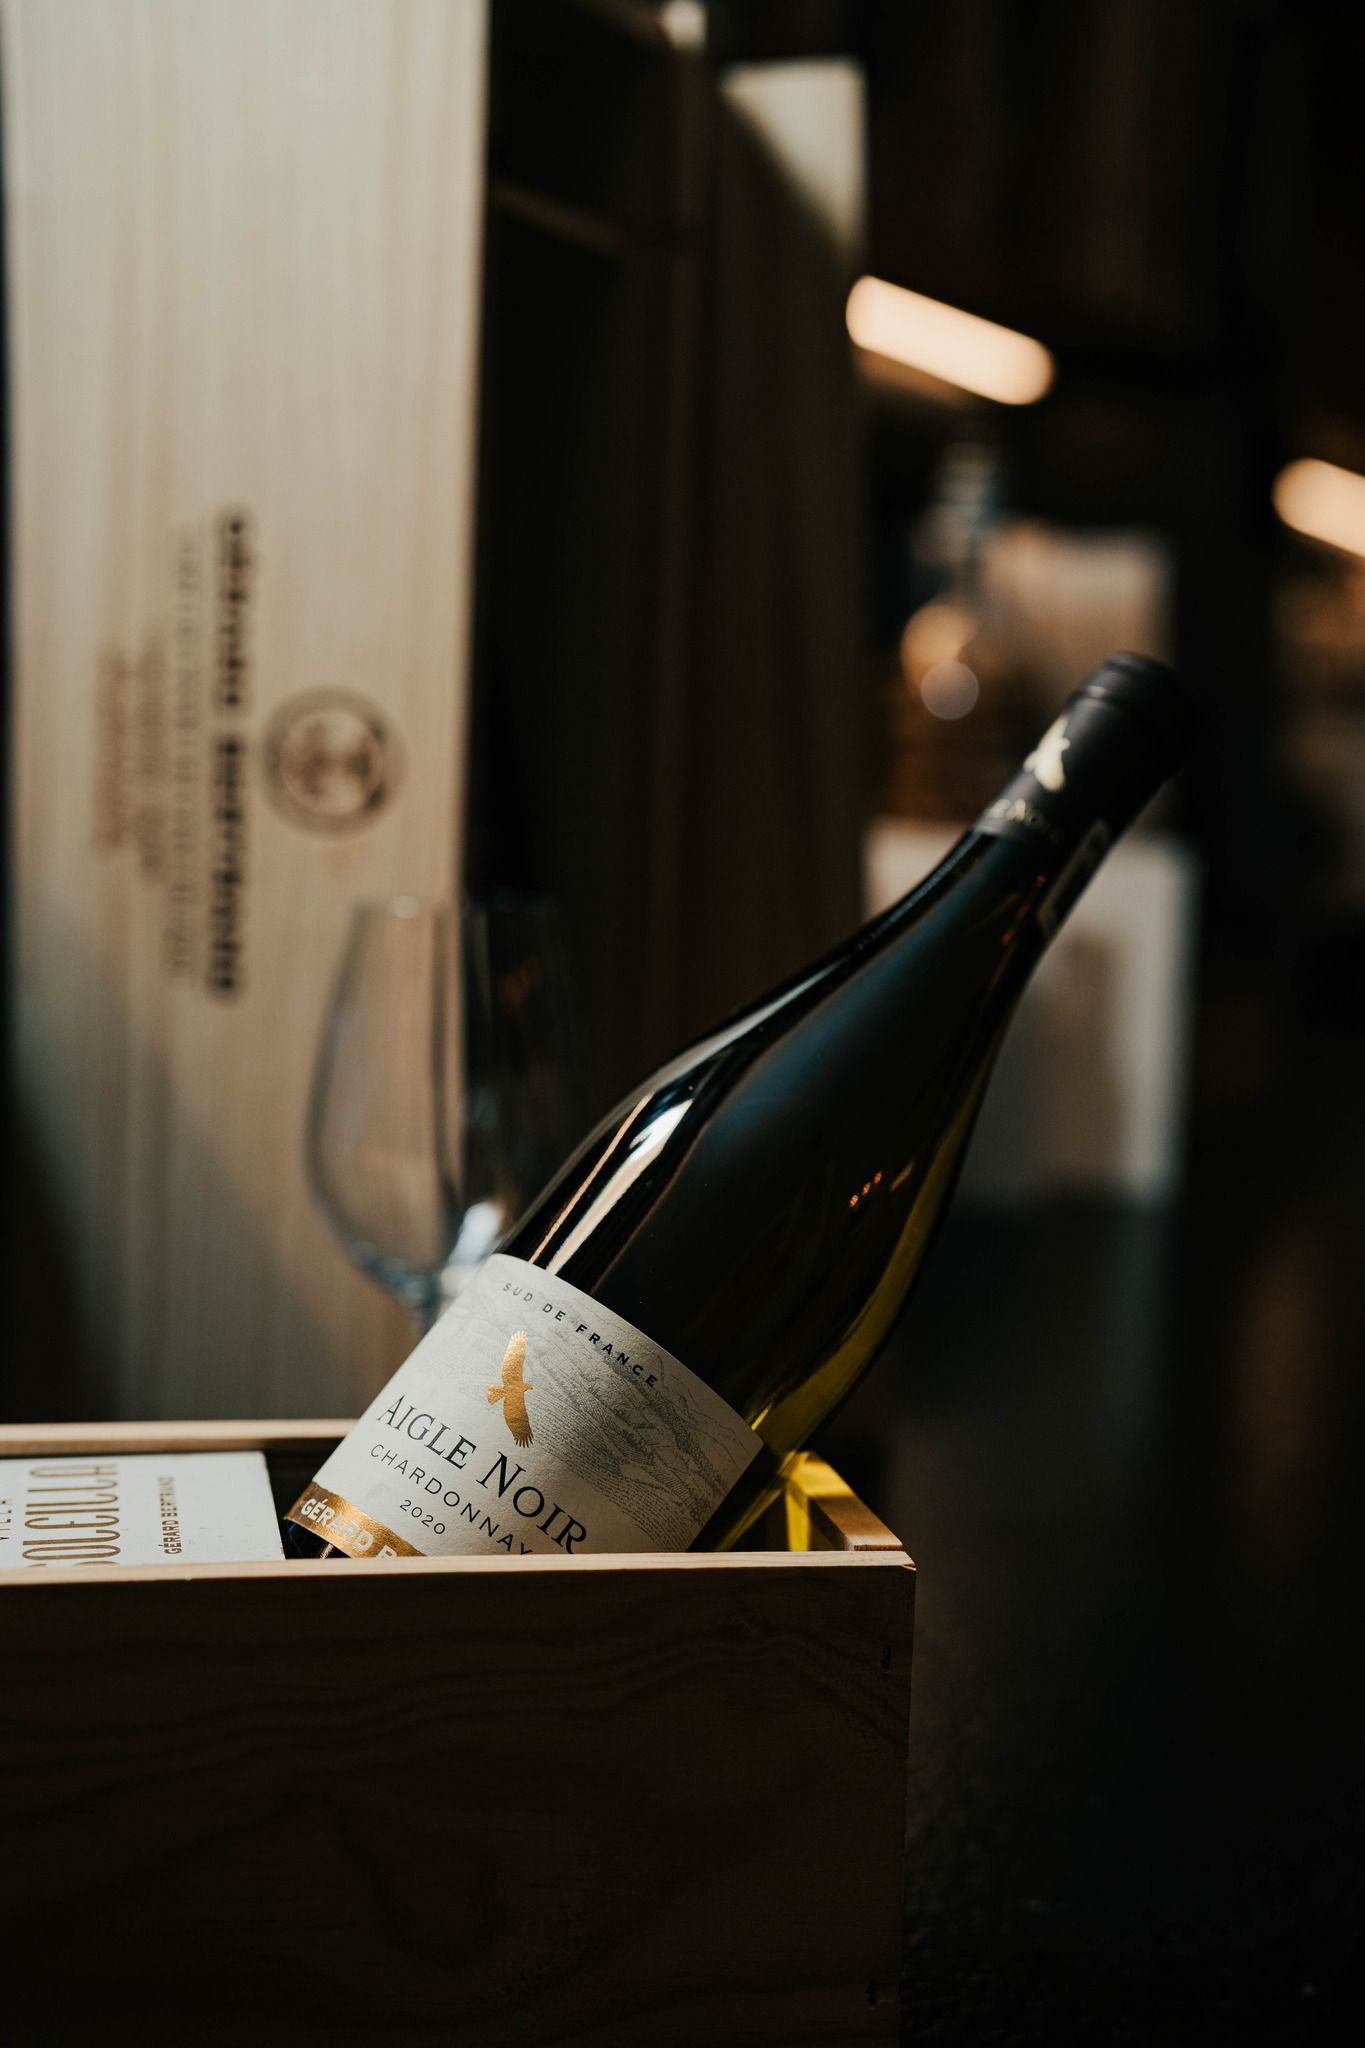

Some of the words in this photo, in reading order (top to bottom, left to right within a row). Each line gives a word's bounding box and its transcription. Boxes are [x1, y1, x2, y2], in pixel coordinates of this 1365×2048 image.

[502, 1282, 535, 1304] SUD
[541, 1302, 568, 1322] DE
[575, 1323, 659, 1388] FRANCE
[370, 1444, 534, 1555] CHARDONNAY
[376, 1393, 477, 1470] AIGLE
[476, 1451, 588, 1554] NOIR
[158, 1519, 182, 1555] GÉRARD
[300, 1498, 374, 1553] GÉRARD
[399, 1498, 447, 1536] 2020
